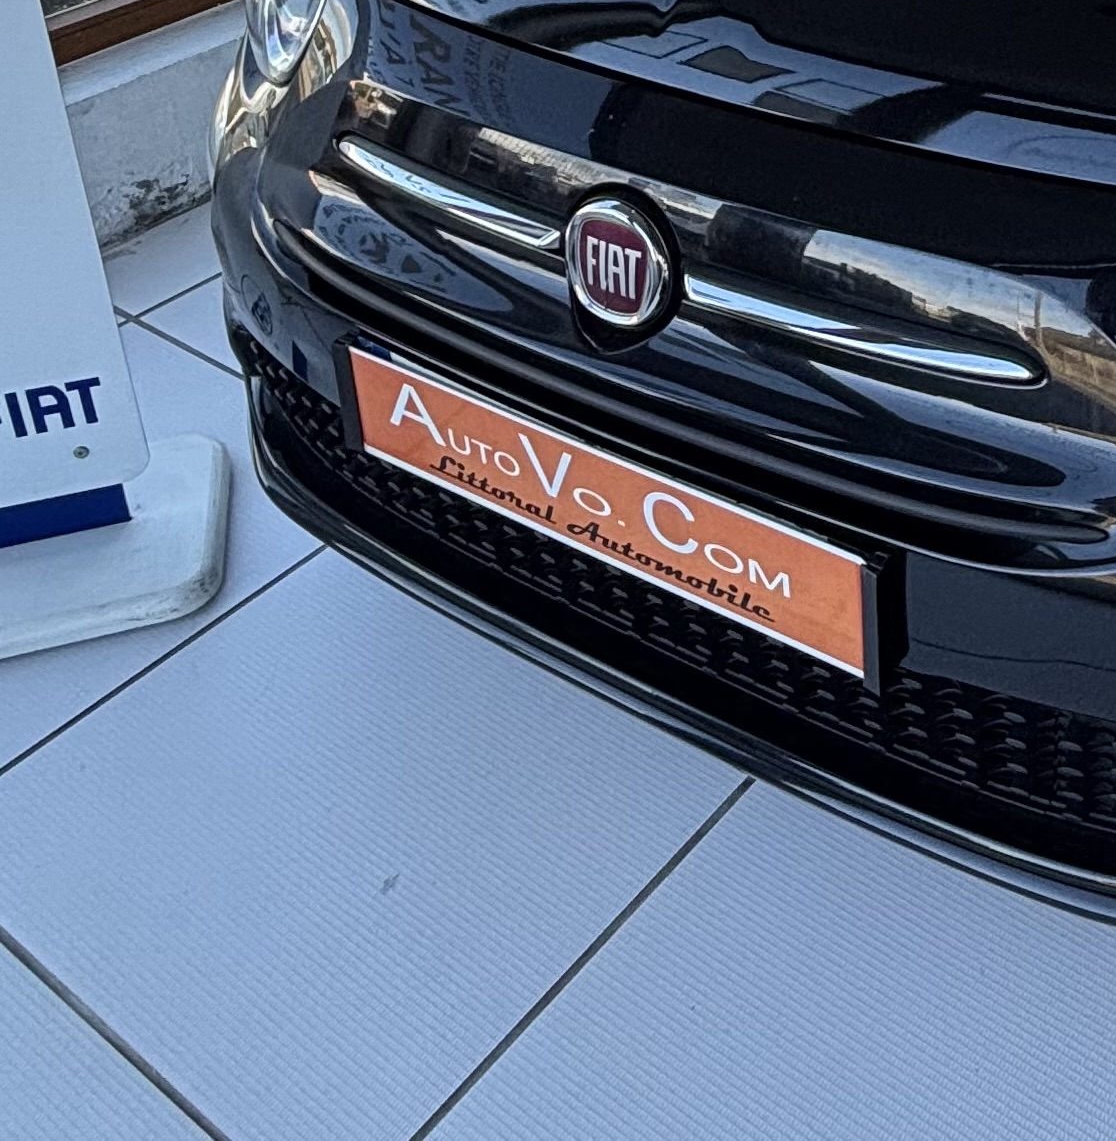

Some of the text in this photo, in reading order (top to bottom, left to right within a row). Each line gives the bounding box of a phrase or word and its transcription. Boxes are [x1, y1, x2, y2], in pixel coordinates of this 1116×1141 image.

[587, 235, 642, 300] FIAT
[0, 376, 101, 439] IAT
[429, 455, 776, 624] Littoral Automobile
